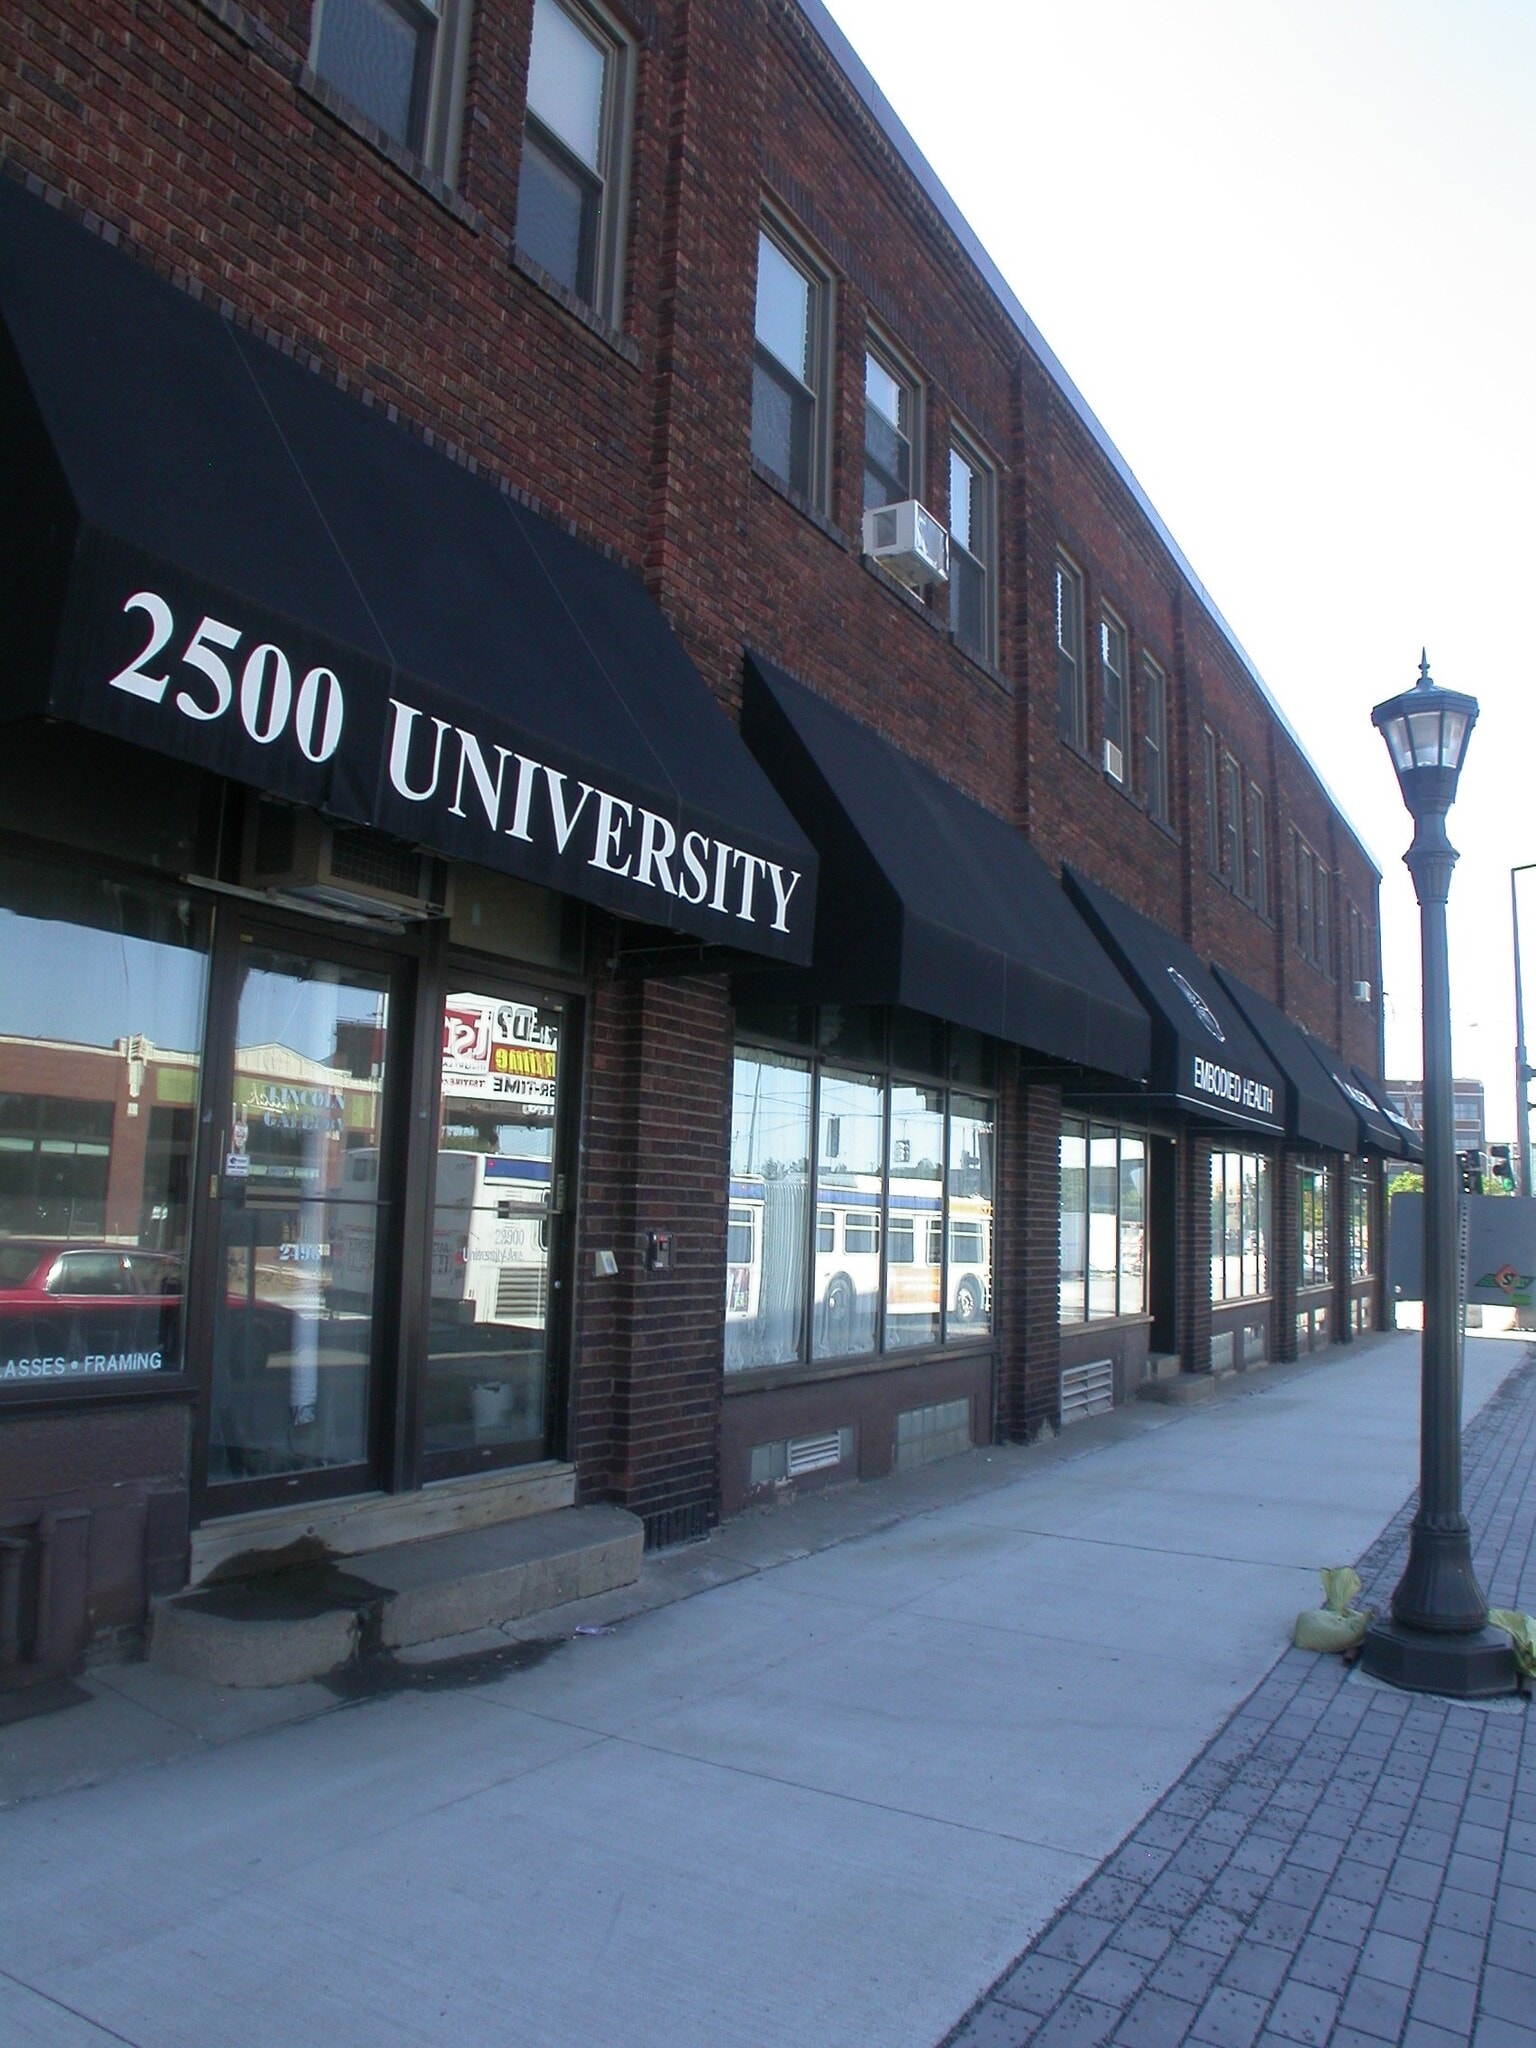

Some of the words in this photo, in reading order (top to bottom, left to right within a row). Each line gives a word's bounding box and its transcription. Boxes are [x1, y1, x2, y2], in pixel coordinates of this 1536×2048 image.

[108, 590, 345, 764] 2500
[388, 697, 802, 934] UNIVERSITY
[265, 1085, 345, 1110] LINCOLN
[1194, 1055, 1241, 1103] EMBODIED
[1242, 1077, 1273, 1114] HEALTH
[0, 1357, 66, 1378] ASSES
[84, 1351, 162, 1373] FRAMING
